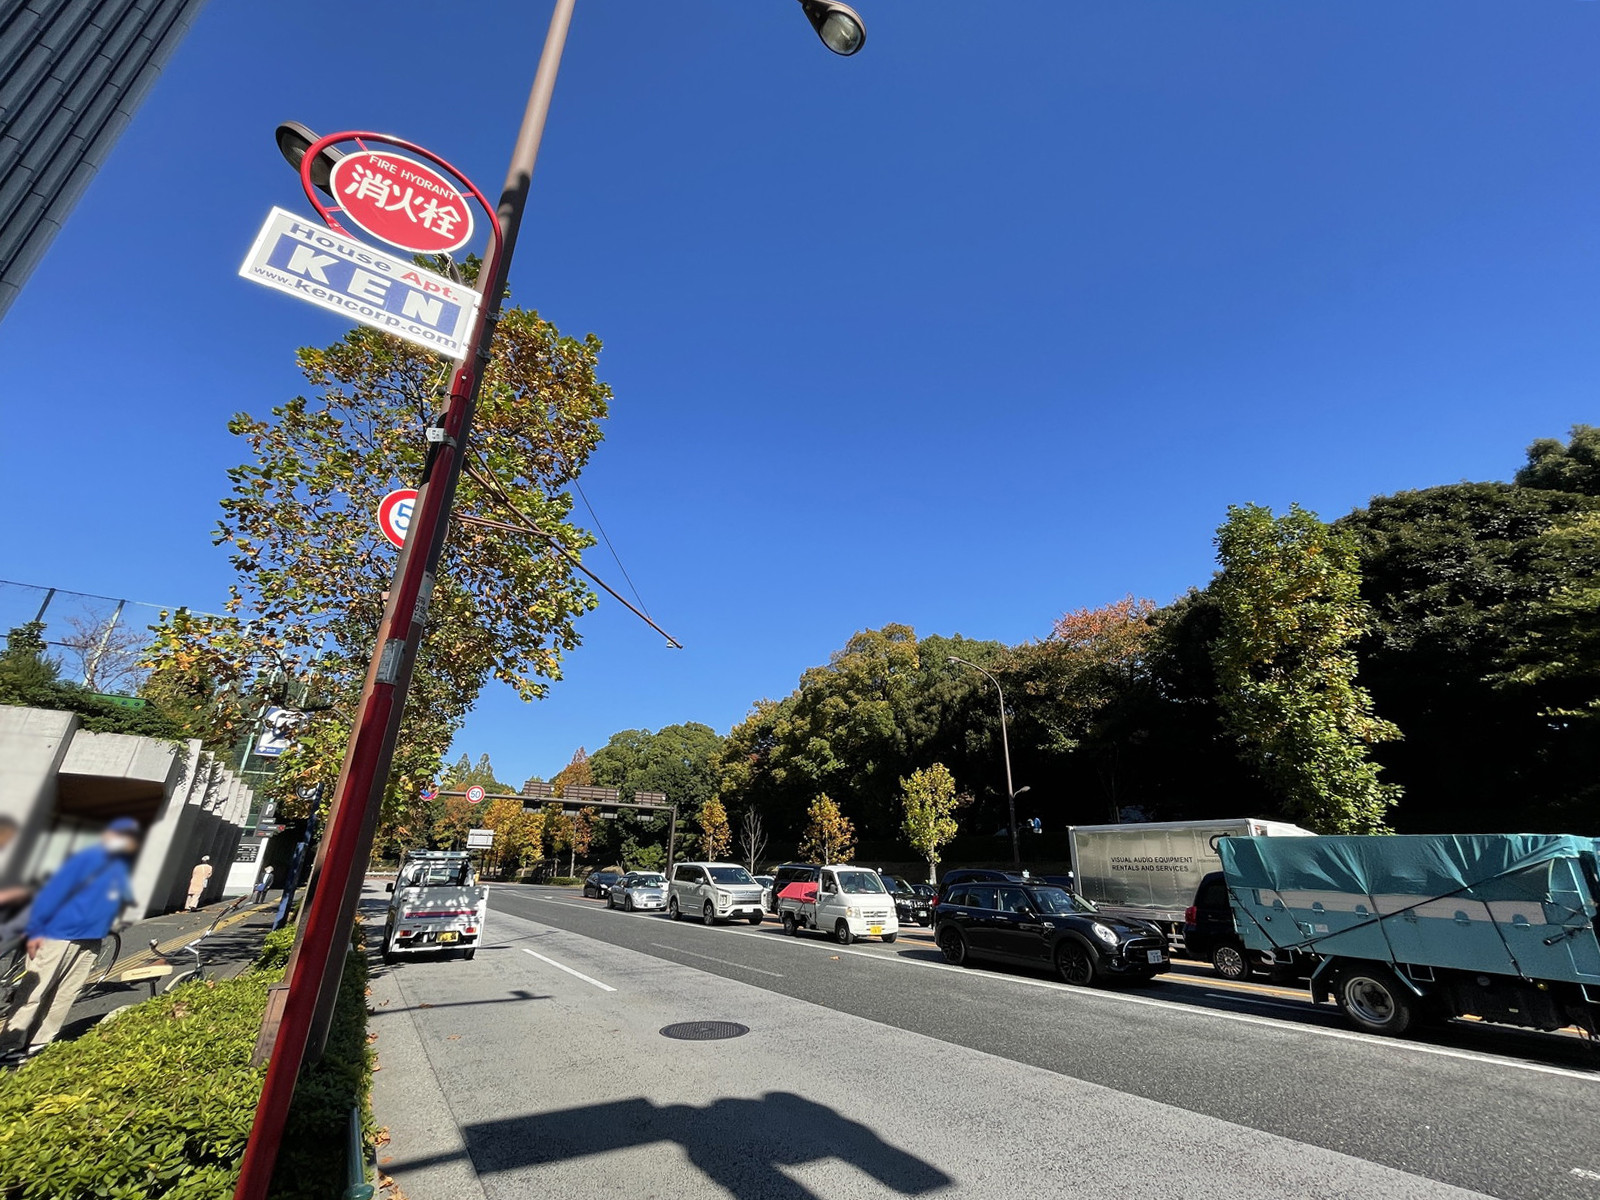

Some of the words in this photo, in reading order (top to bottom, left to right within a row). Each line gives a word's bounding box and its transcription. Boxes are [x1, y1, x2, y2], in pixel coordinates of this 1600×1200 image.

[344, 164, 461, 240] 消火栓
[369, 155, 397, 175] FIRE
[401, 169, 457, 201] HYDRANT
[287, 244, 444, 327] KEN
[290, 223, 392, 273] House
[400, 271, 459, 302] Apt.
[253, 266, 458, 350] www.kencorp.com
[394, 502, 413, 531] 5
[265, 804, 273, 815] P
[470, 790, 481, 799] 50
